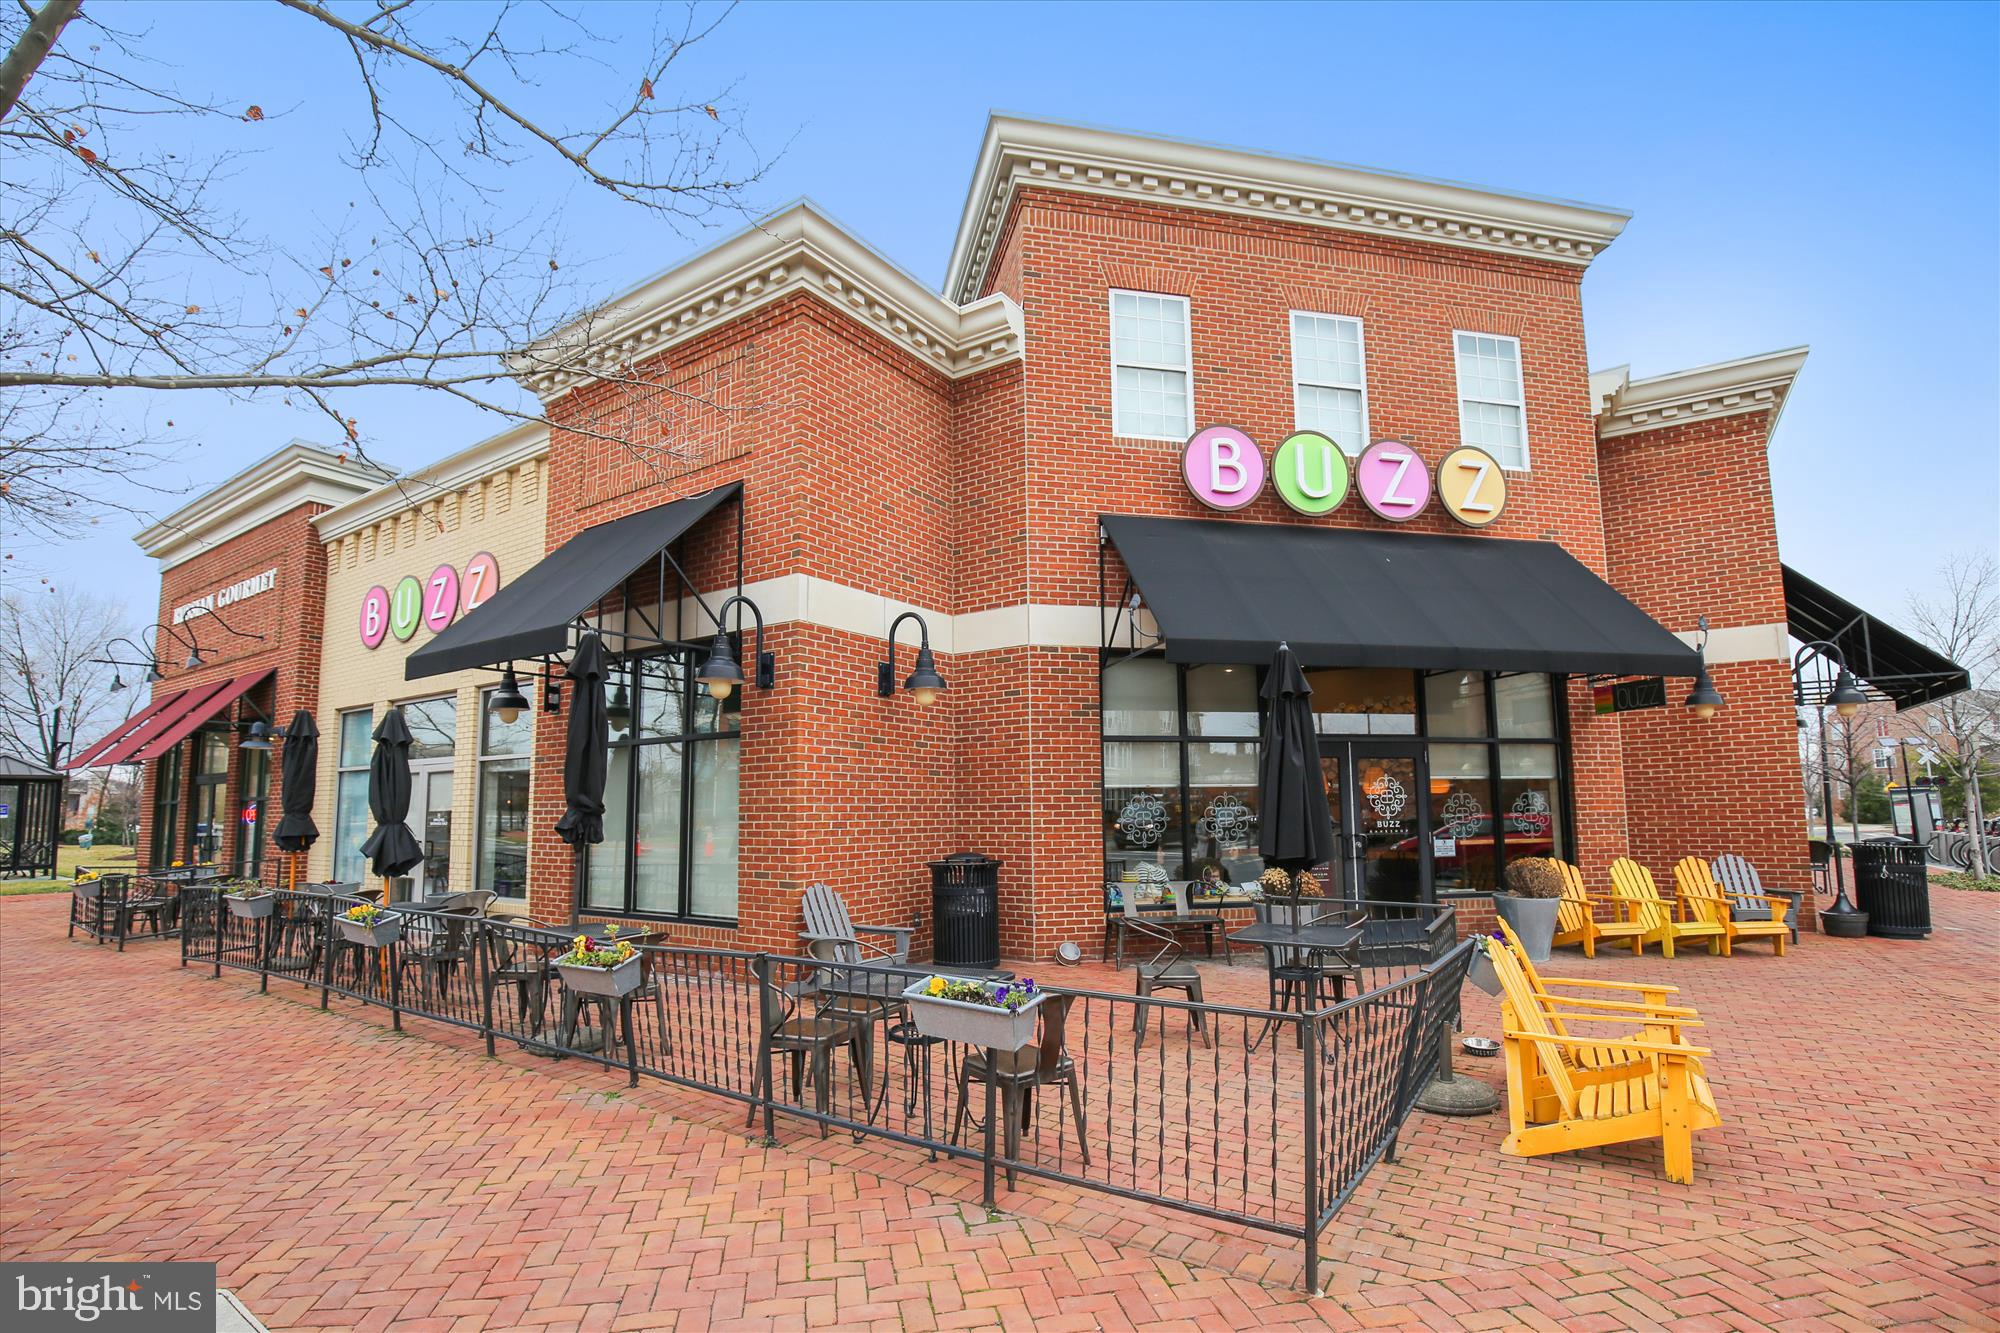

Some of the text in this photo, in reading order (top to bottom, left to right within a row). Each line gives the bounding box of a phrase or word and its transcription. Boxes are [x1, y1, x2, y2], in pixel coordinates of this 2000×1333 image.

[1209, 437, 1494, 512] BUZZ
[218, 568, 277, 608] GOURMET
[366, 564, 488, 637] BUZZ
[1376, 820, 1401, 828] BUZZ
